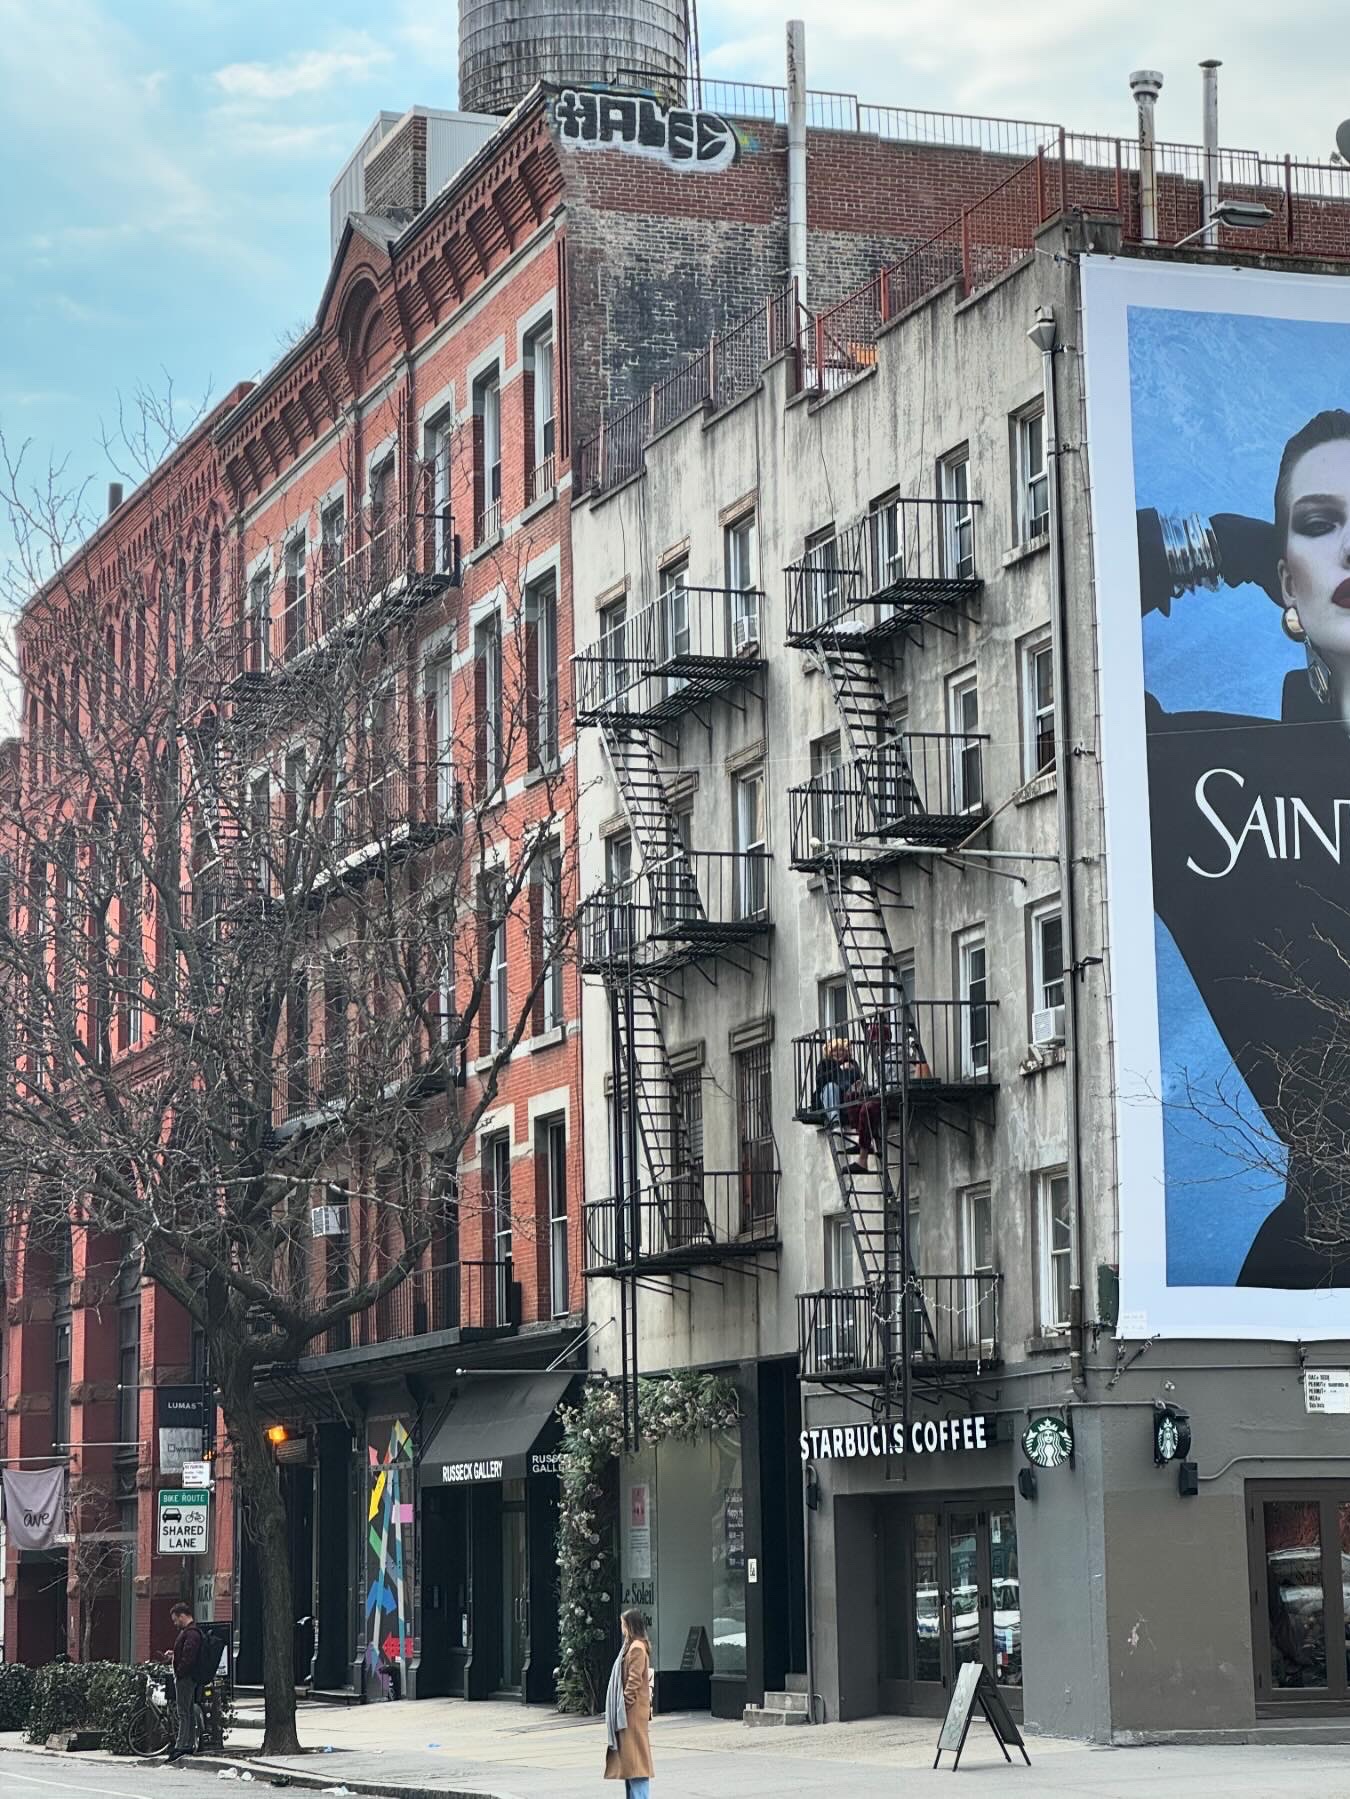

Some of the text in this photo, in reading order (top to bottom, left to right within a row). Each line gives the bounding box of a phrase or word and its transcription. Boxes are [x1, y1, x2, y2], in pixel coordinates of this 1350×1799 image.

[167, 1401, 197, 1410] LUMAS
[911, 1416, 987, 1454] COFFEE
[532, 1454, 566, 1464] RUSS
[443, 1460, 503, 1482] RUSSECK GALLERY
[532, 1464, 566, 1473] GALLE
[163, 1494, 205, 1503] BIKE ROUTE
[162, 1525, 205, 1536] SHARED
[169, 1537, 197, 1549] LANE
[631, 1581, 655, 1605] Soleil
